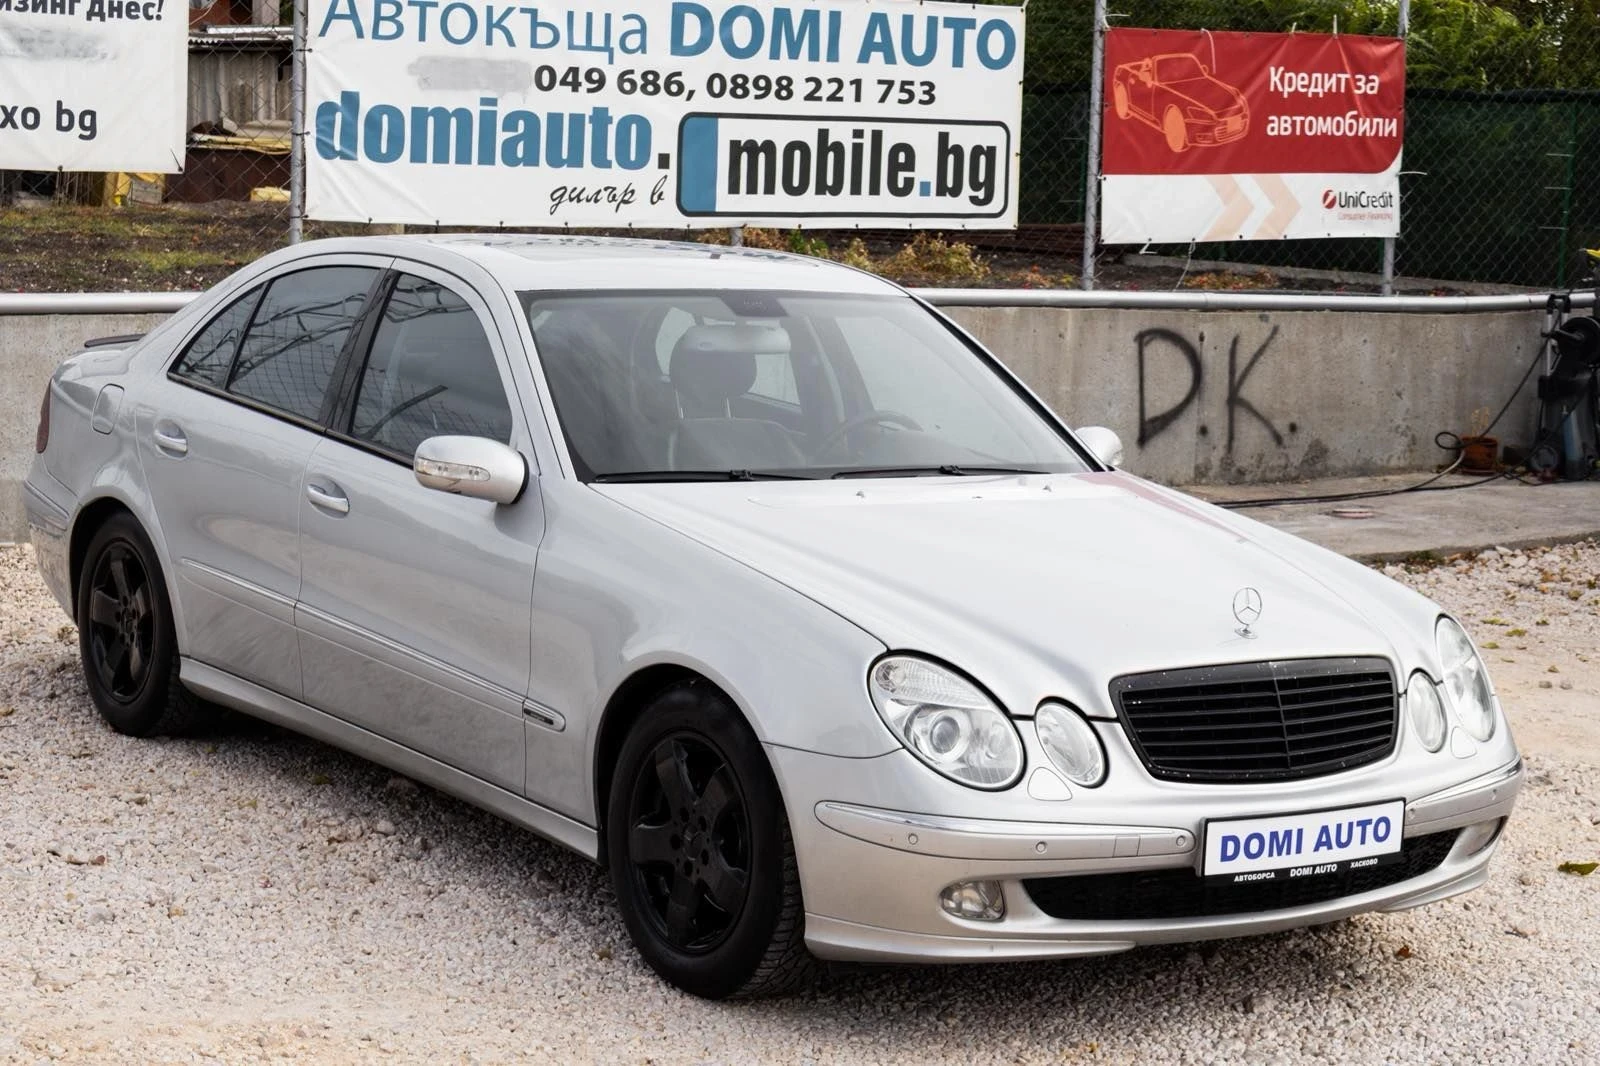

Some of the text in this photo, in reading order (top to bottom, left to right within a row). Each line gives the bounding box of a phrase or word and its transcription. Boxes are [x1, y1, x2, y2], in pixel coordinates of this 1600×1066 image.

[86, 0, 165, 22] днес!
[670, 2, 1017, 71] DOMI AUTO
[534, 64, 936, 106] 049 686, 0898 221 753
[1269, 66, 1380, 99] Кредит за
[56, 100, 97, 141] bg
[1266, 110, 1398, 137] автомобили
[727, 128, 997, 207] mobile.bg
[549, 182, 637, 216] дилър
[1338, 190, 1394, 209] UniCredit
[1219, 815, 1392, 863] DOMI AUTO
[1233, 871, 1276, 882] АВТОБОРСА
[1289, 863, 1338, 878] DOMI AUTO
[1350, 857, 1379, 869] ХАСКОВО
